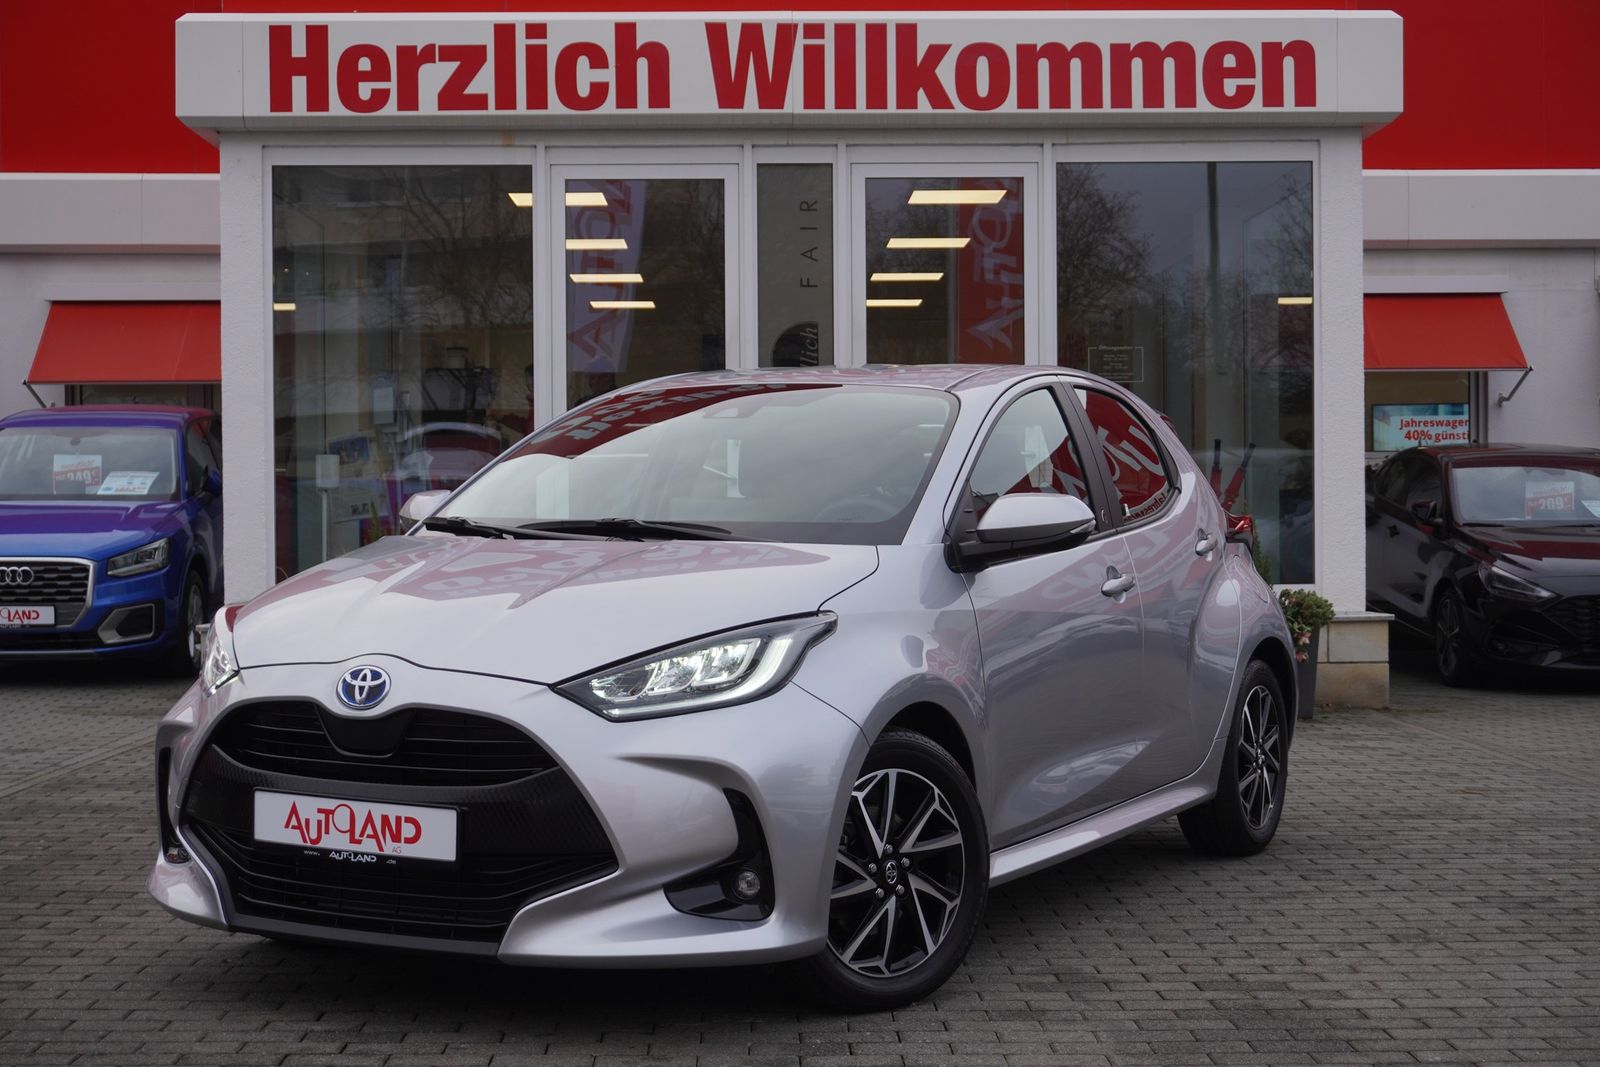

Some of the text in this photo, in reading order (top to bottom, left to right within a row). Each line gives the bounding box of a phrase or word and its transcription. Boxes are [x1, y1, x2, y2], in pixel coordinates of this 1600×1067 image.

[268, 22, 1318, 113] Herzlich Willkommen
[800, 200, 818, 288] FAIR
[800, 326, 819, 367] lich
[1404, 429, 1433, 441] 40%
[284, 800, 422, 853] AUTOLAND
